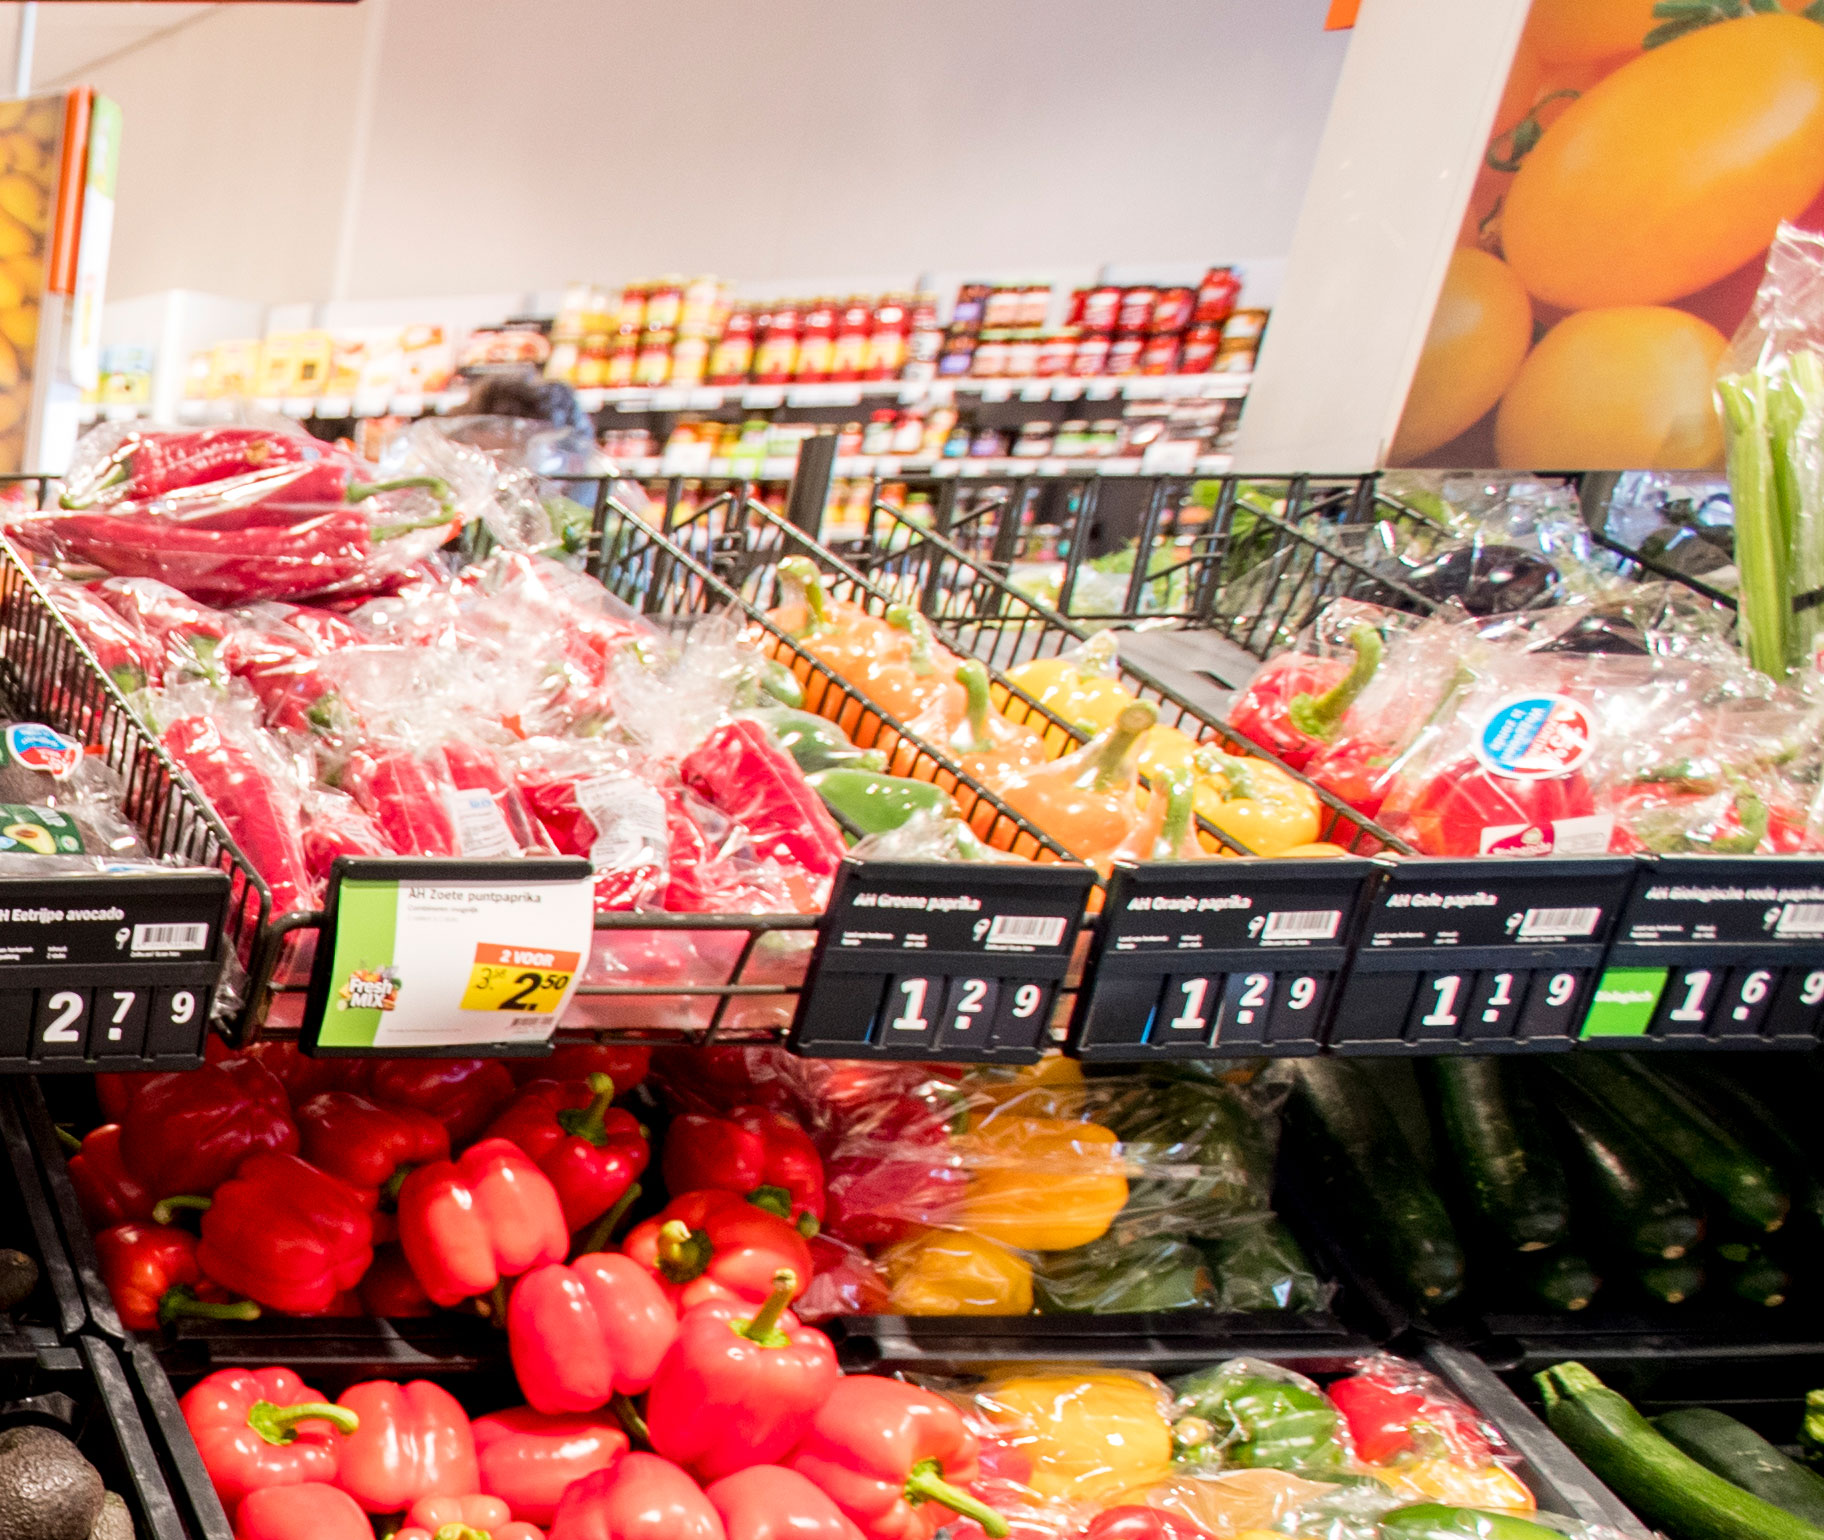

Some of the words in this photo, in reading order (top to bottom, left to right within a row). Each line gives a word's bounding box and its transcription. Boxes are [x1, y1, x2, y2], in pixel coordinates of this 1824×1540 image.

[408, 889, 426, 900] AH
[430, 889, 464, 900] Zoete
[468, 891, 542, 904] puntpaprika
[926, 895, 982, 911] paprika
[12, 908, 64, 924] Eetrijpe
[66, 907, 125, 921] avocado
[499, 950, 510, 962] 2
[513, 952, 555, 967] VOOR
[349, 978, 392, 994] Fresh
